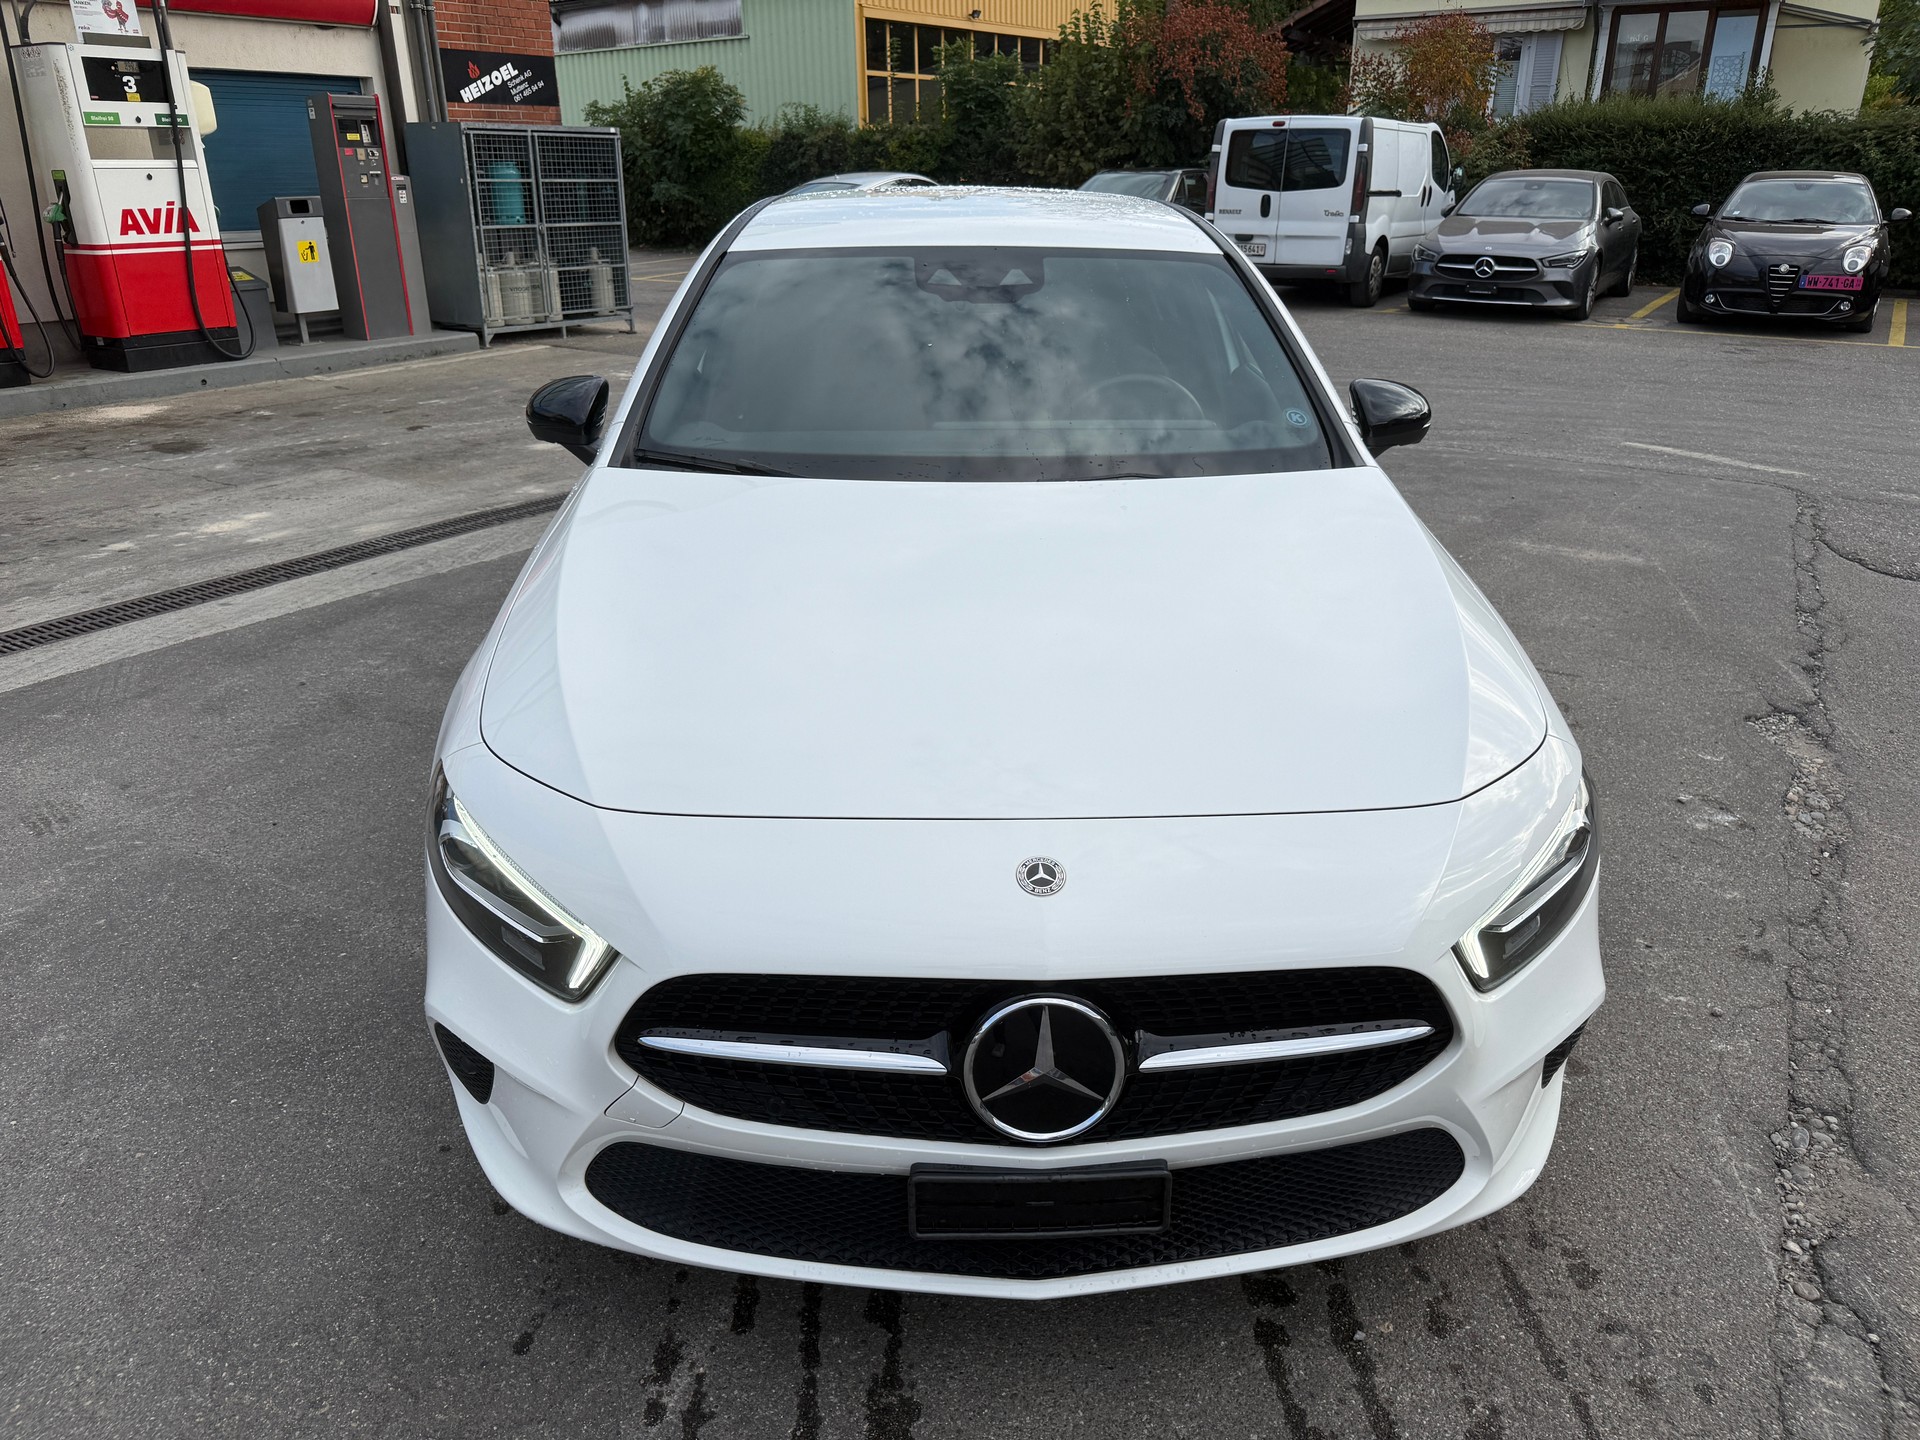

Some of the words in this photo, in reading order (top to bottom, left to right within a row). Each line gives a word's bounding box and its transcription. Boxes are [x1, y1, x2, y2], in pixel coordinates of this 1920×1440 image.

[122, 75, 137, 93] 3
[460, 62, 519, 103] HEIZOEL
[523, 69, 532, 79] AG
[120, 201, 201, 236] AVIA
